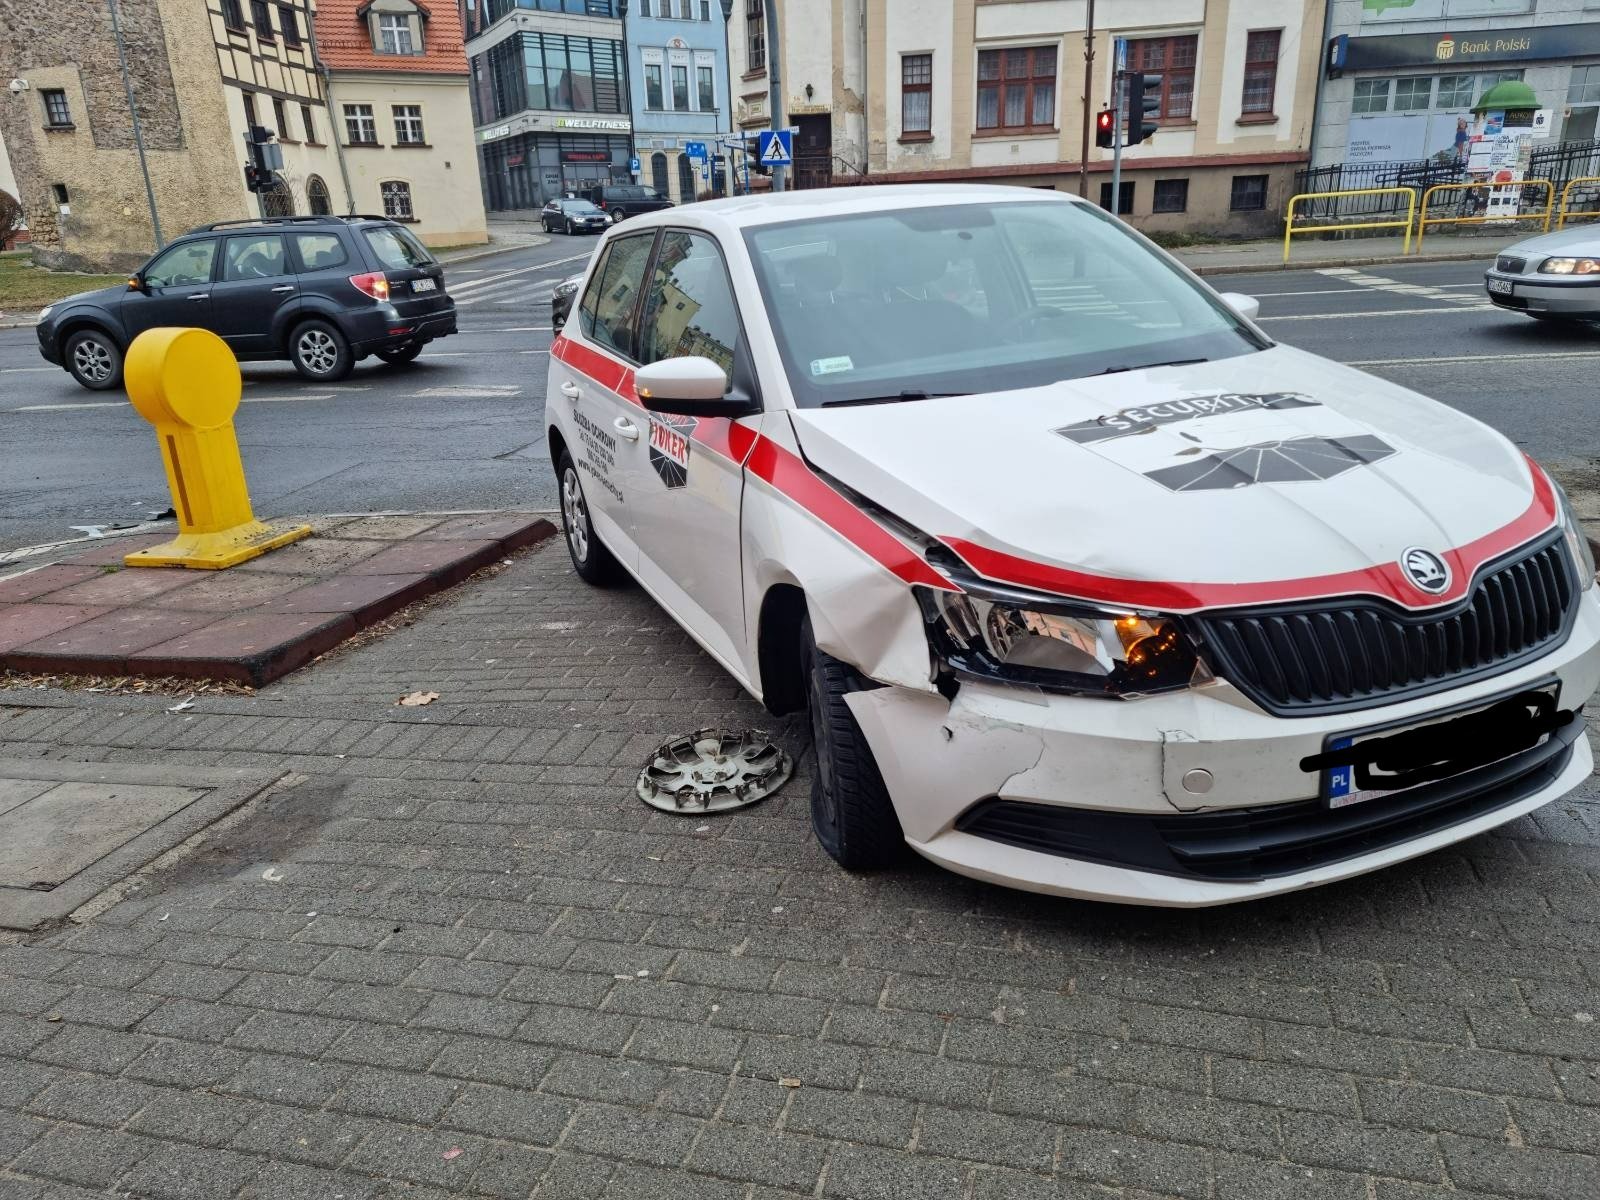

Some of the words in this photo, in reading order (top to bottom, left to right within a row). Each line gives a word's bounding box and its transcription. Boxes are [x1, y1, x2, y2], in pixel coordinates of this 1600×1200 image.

[1461, 41, 1490, 53] Bank
[1495, 38, 1530, 52] Polski
[565, 119, 631, 130] WELLFITNESS
[1105, 393, 1271, 430] SECURITY
[652, 422, 686, 464] JOKER
[1332, 774, 1347, 789] PL
